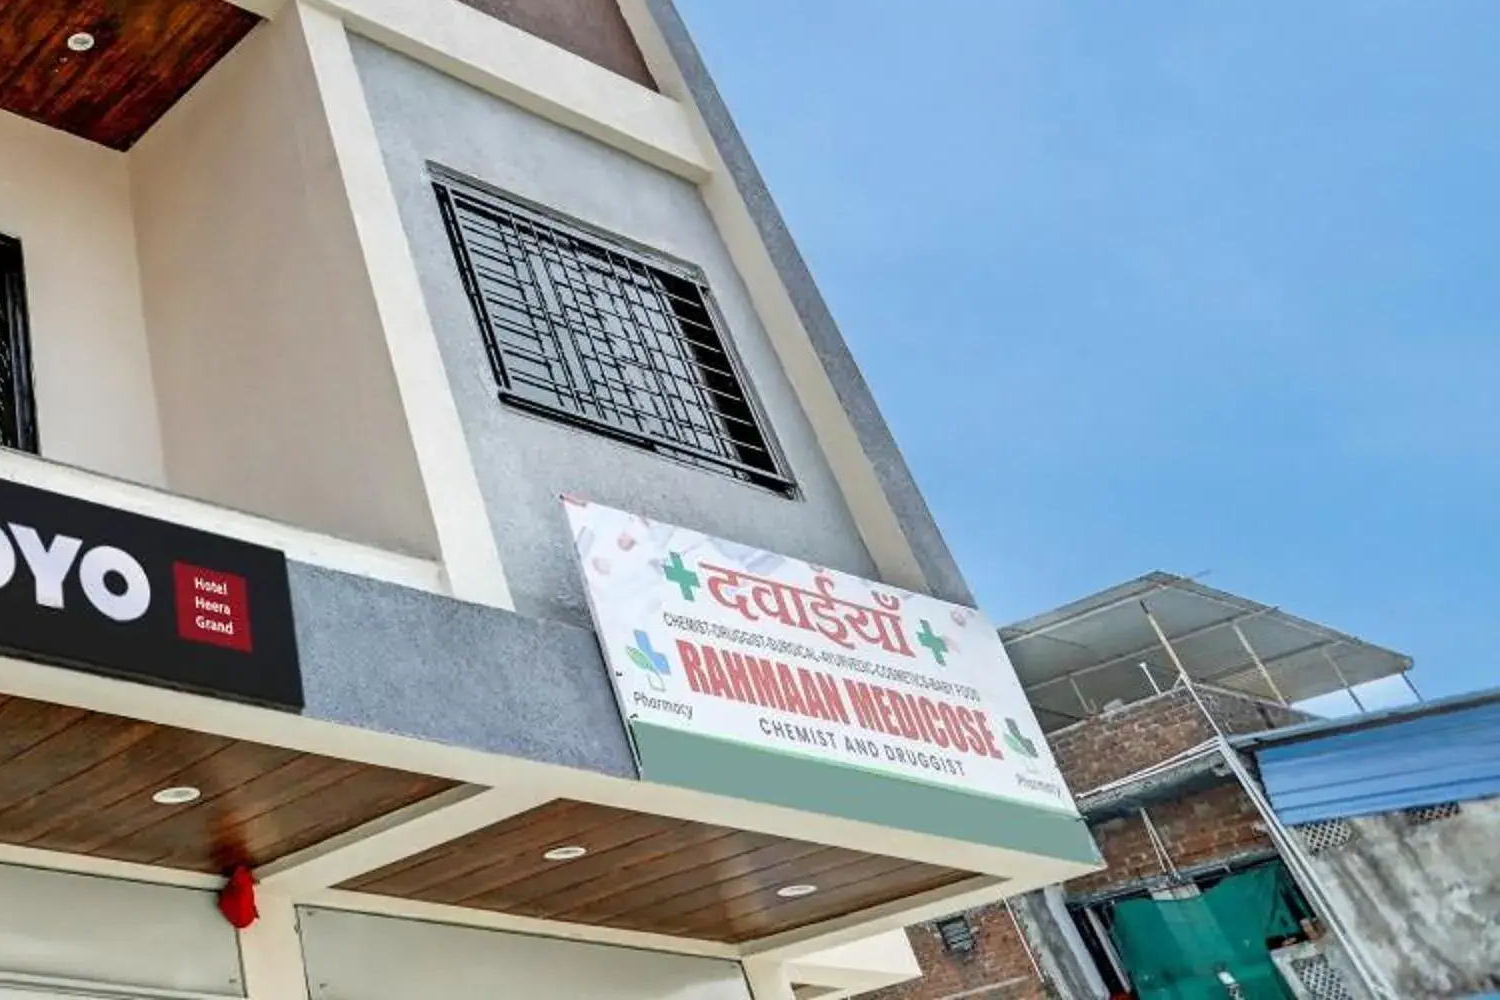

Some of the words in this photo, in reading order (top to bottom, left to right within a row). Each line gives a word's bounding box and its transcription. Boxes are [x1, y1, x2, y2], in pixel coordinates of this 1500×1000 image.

[193, 577, 228, 596] Hotel
[195, 595, 231, 616] Heera
[195, 615, 234, 635] Grand
[633, 690, 694, 720] Pharmacy
[675, 639, 850, 725] RAHMAAN
[843, 677, 1004, 760] MEDICOSE
[758, 717, 837, 749] CHEMIST
[843, 735, 880, 758] AND
[883, 744, 966, 776] DRUGGIST
